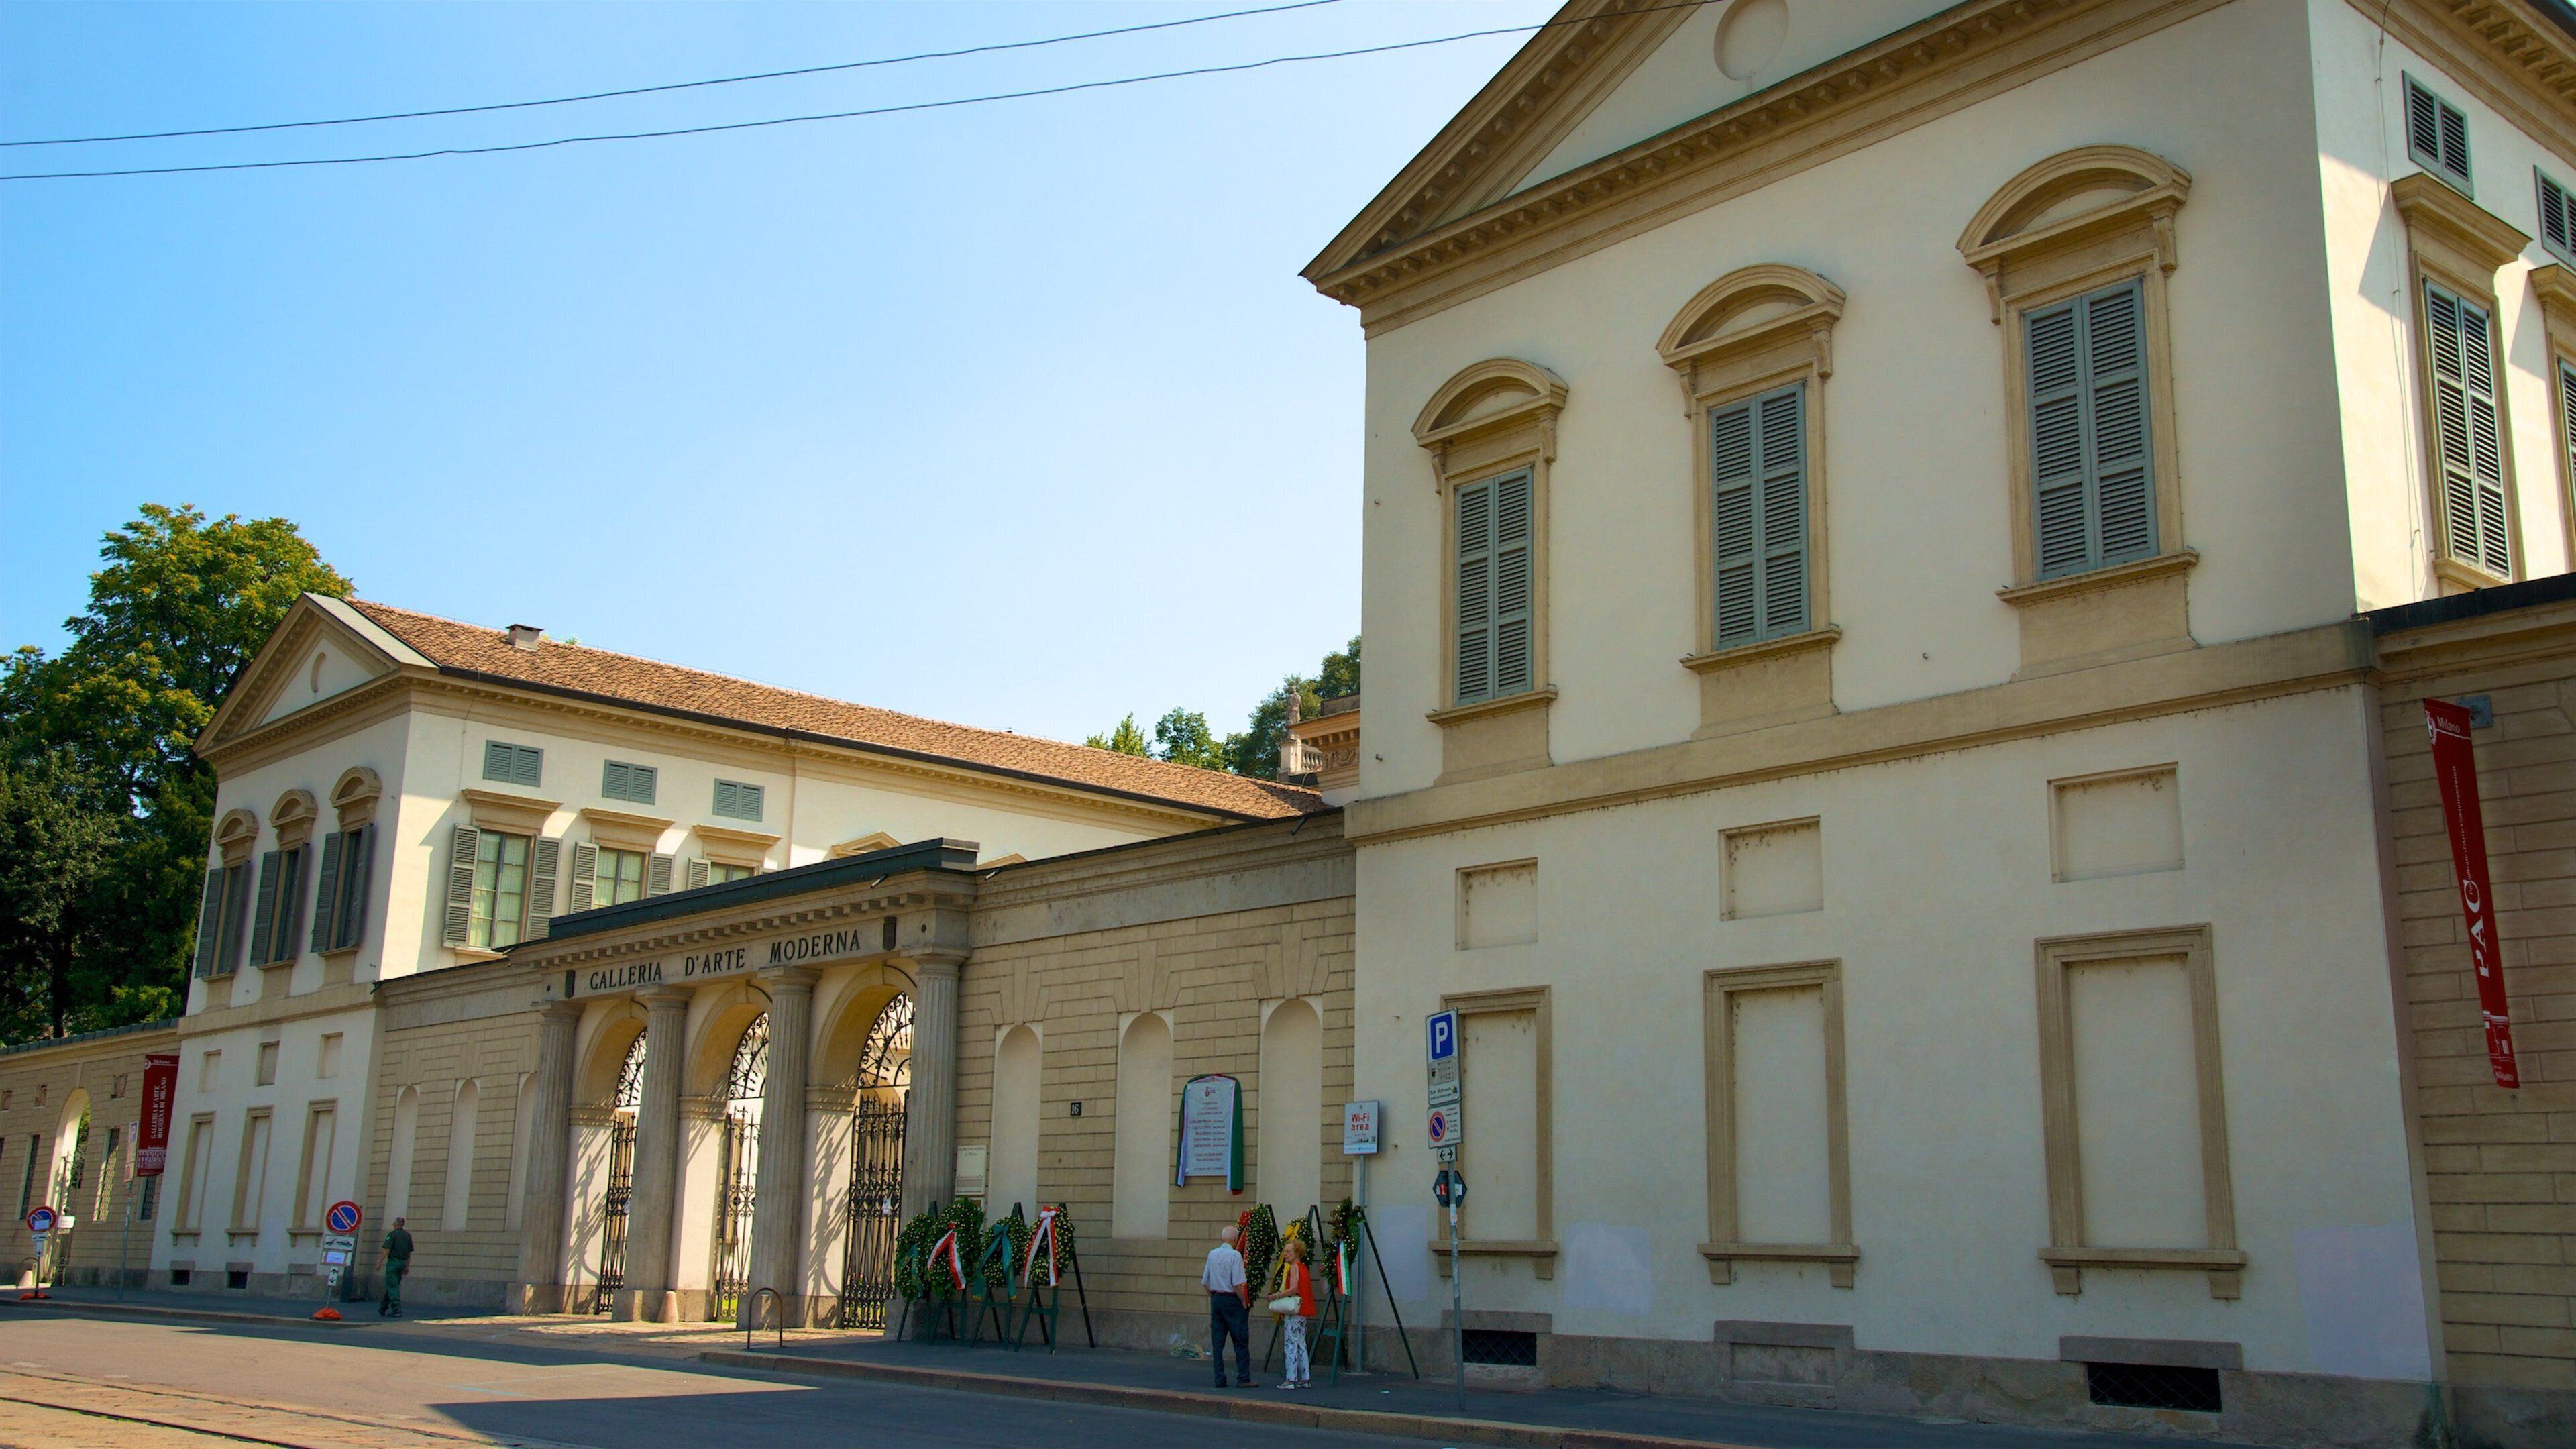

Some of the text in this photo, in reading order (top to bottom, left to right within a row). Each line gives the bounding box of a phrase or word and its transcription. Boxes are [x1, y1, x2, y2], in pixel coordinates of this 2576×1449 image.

[2436, 716, 2461, 733] Milano
[2463, 879, 2489, 978] PAC
[590, 929, 861, 991] GALLERIA D'ARTE MODERNA
[1435, 1021, 1448, 1054] P
[150, 1085, 160, 1139] GALLERIA D'ARTE
[157, 1109, 165, 1139] MODERNA
[1071, 1104, 1079, 1115] 16
[1351, 1113, 1370, 1122] Wi-Fi
